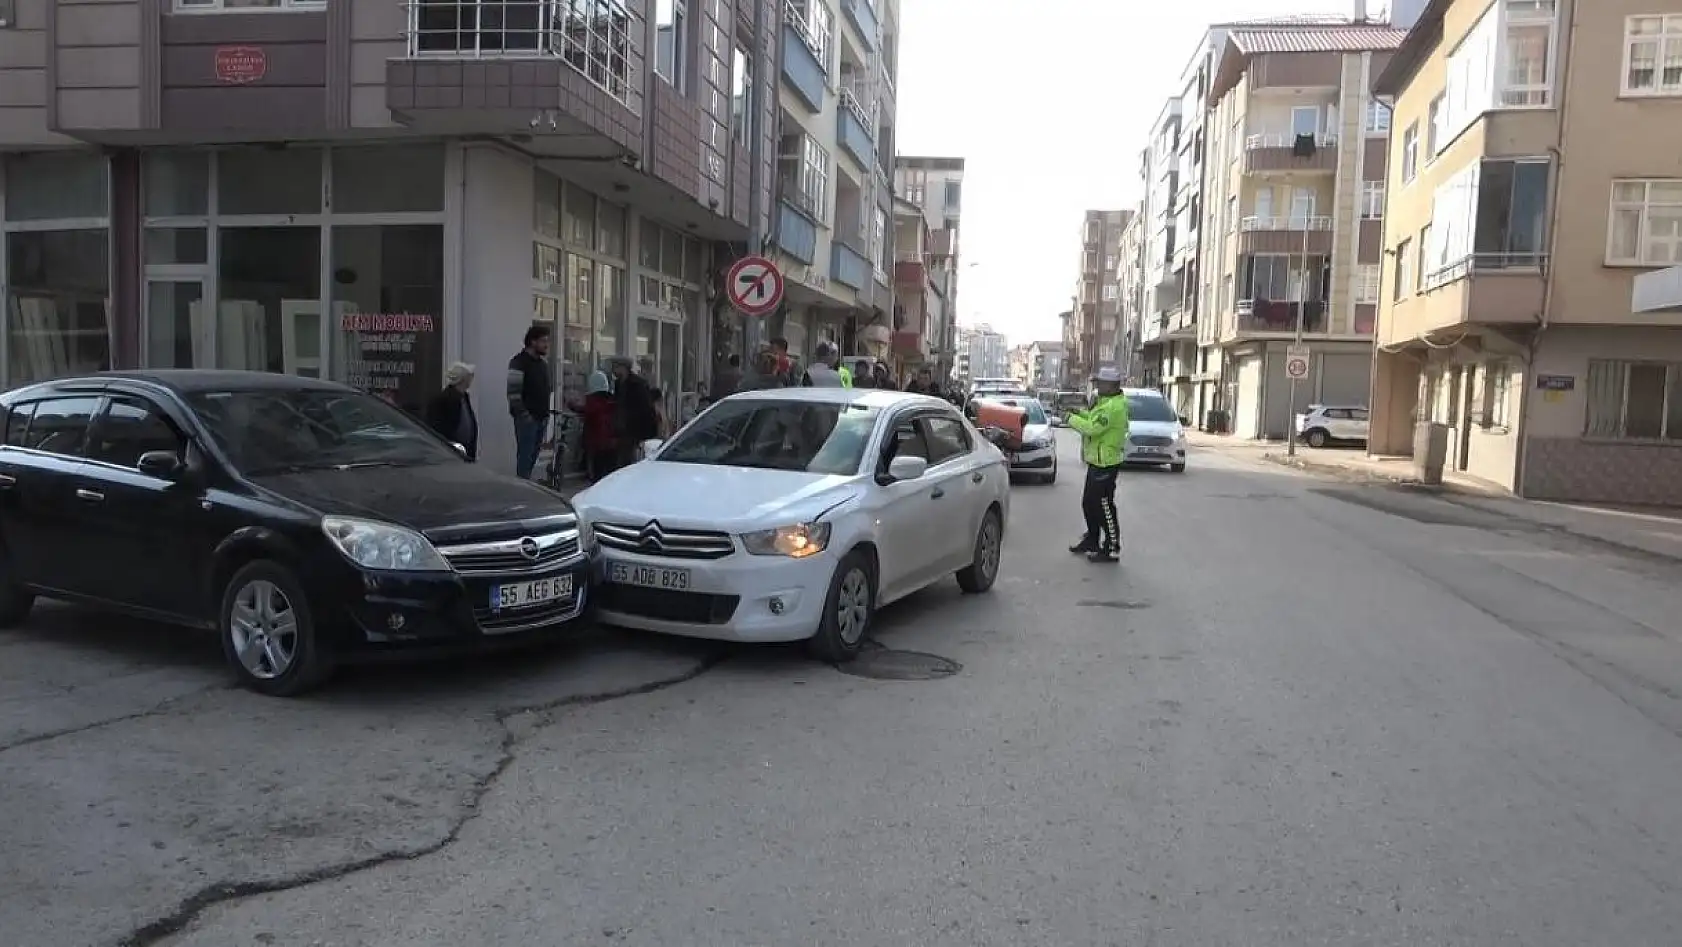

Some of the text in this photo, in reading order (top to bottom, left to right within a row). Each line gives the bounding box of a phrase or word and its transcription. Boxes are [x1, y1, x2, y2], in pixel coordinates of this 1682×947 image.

[612, 565, 629, 581] 55
[662, 569, 687, 589] 829
[501, 585, 518, 605] 55
